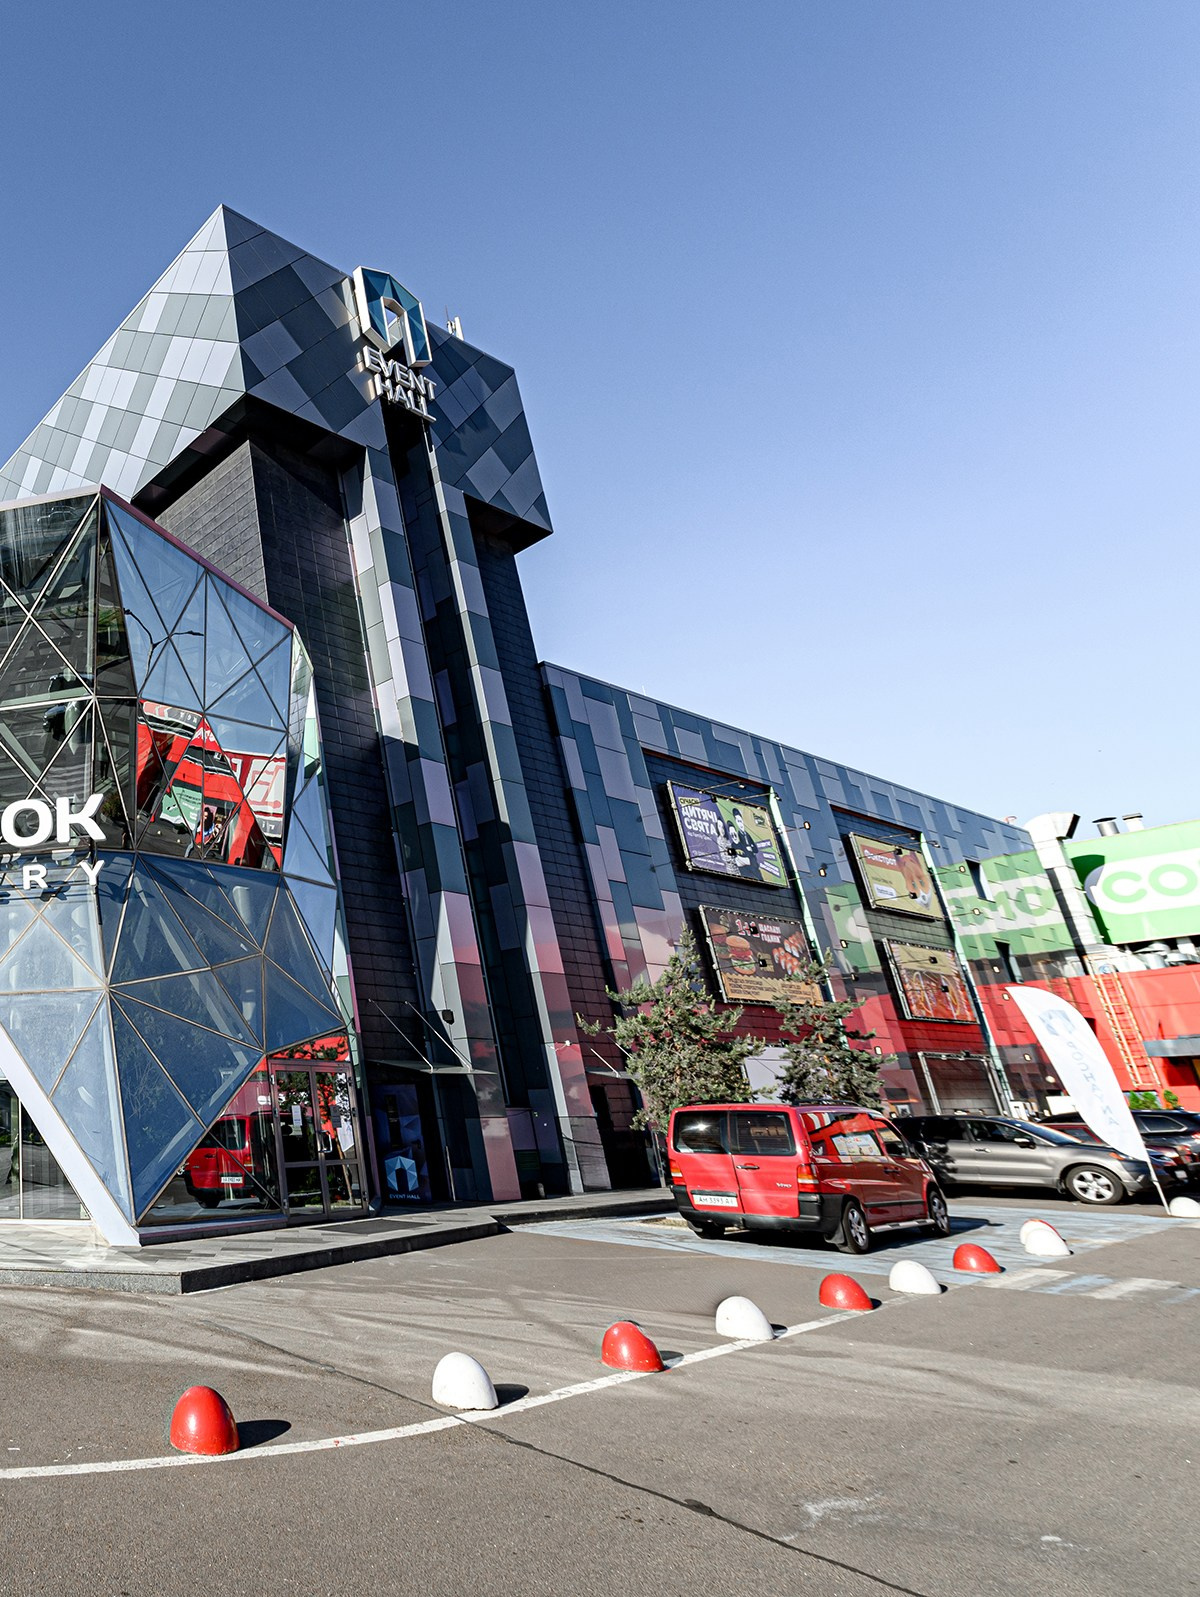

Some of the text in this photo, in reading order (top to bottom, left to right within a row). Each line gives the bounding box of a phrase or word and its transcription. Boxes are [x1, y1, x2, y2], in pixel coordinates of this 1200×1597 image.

[362, 345, 437, 400] EVENT
[373, 373, 437, 423] HALL
[684, 817, 718, 836] СВЯТА
[1102, 858, 1200, 904] CO
